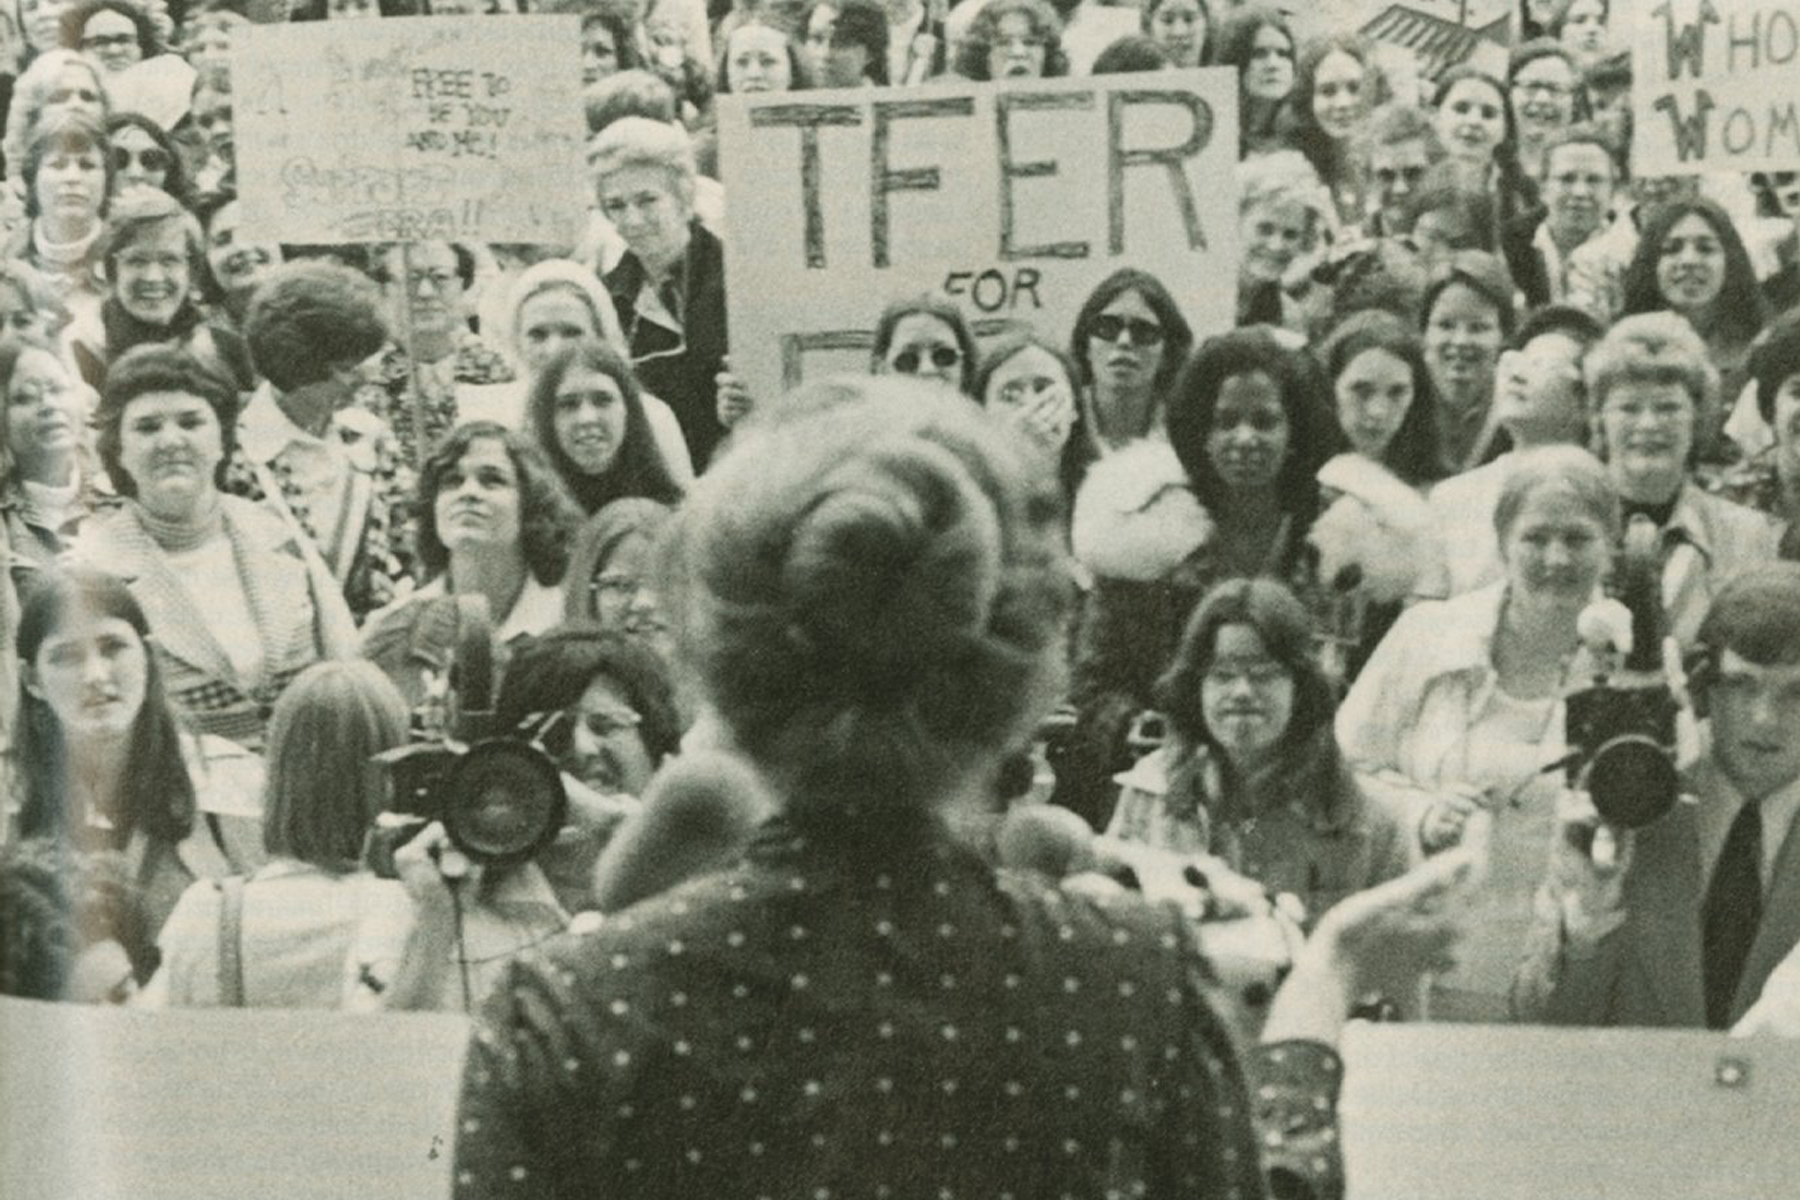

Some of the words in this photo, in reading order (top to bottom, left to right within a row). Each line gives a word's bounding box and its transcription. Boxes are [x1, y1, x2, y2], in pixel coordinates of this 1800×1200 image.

[1651, 0, 1799, 79] WHO
[411, 69, 473, 99] FREE
[1653, 89, 1800, 162] WOM
[750, 90, 1213, 268] TFER
[944, 268, 1041, 313] FOR
